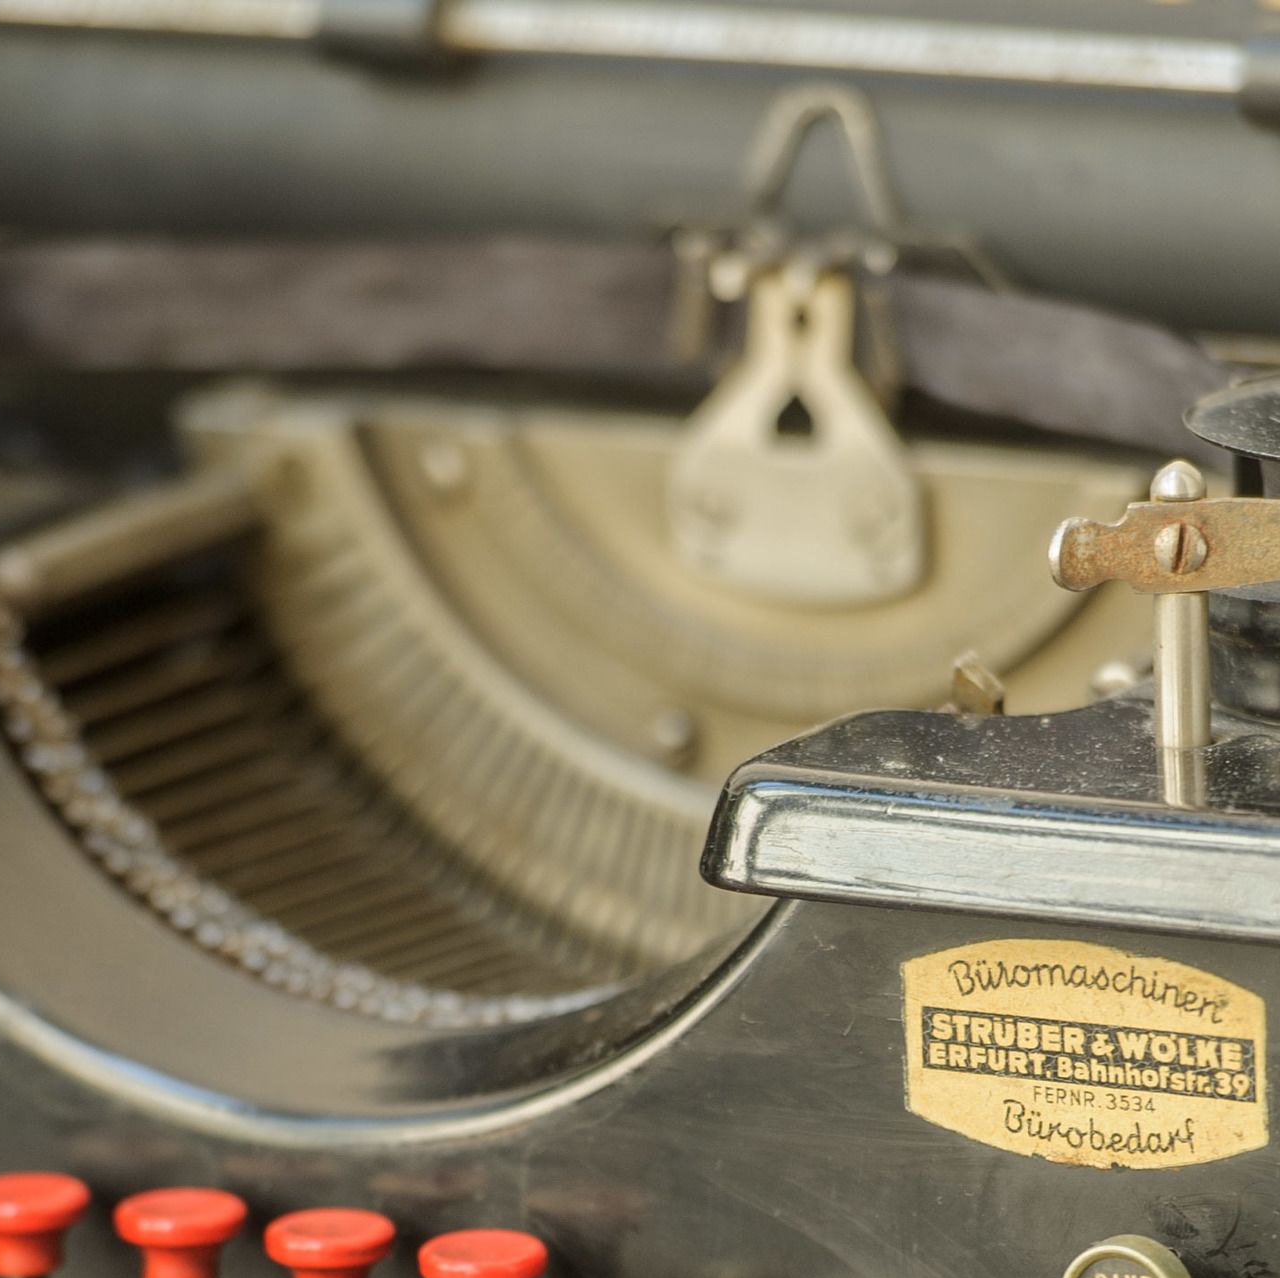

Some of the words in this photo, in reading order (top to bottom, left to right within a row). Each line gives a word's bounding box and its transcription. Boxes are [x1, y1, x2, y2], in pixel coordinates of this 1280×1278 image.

[947, 959, 1223, 1025] Büromaschinen
[930, 1012, 1085, 1054] STRÜBER
[1091, 1033, 1115, 1064] &
[1115, 1030, 1243, 1071] WÖLKE
[1002, 1098, 1196, 1154] Bürobedarf
